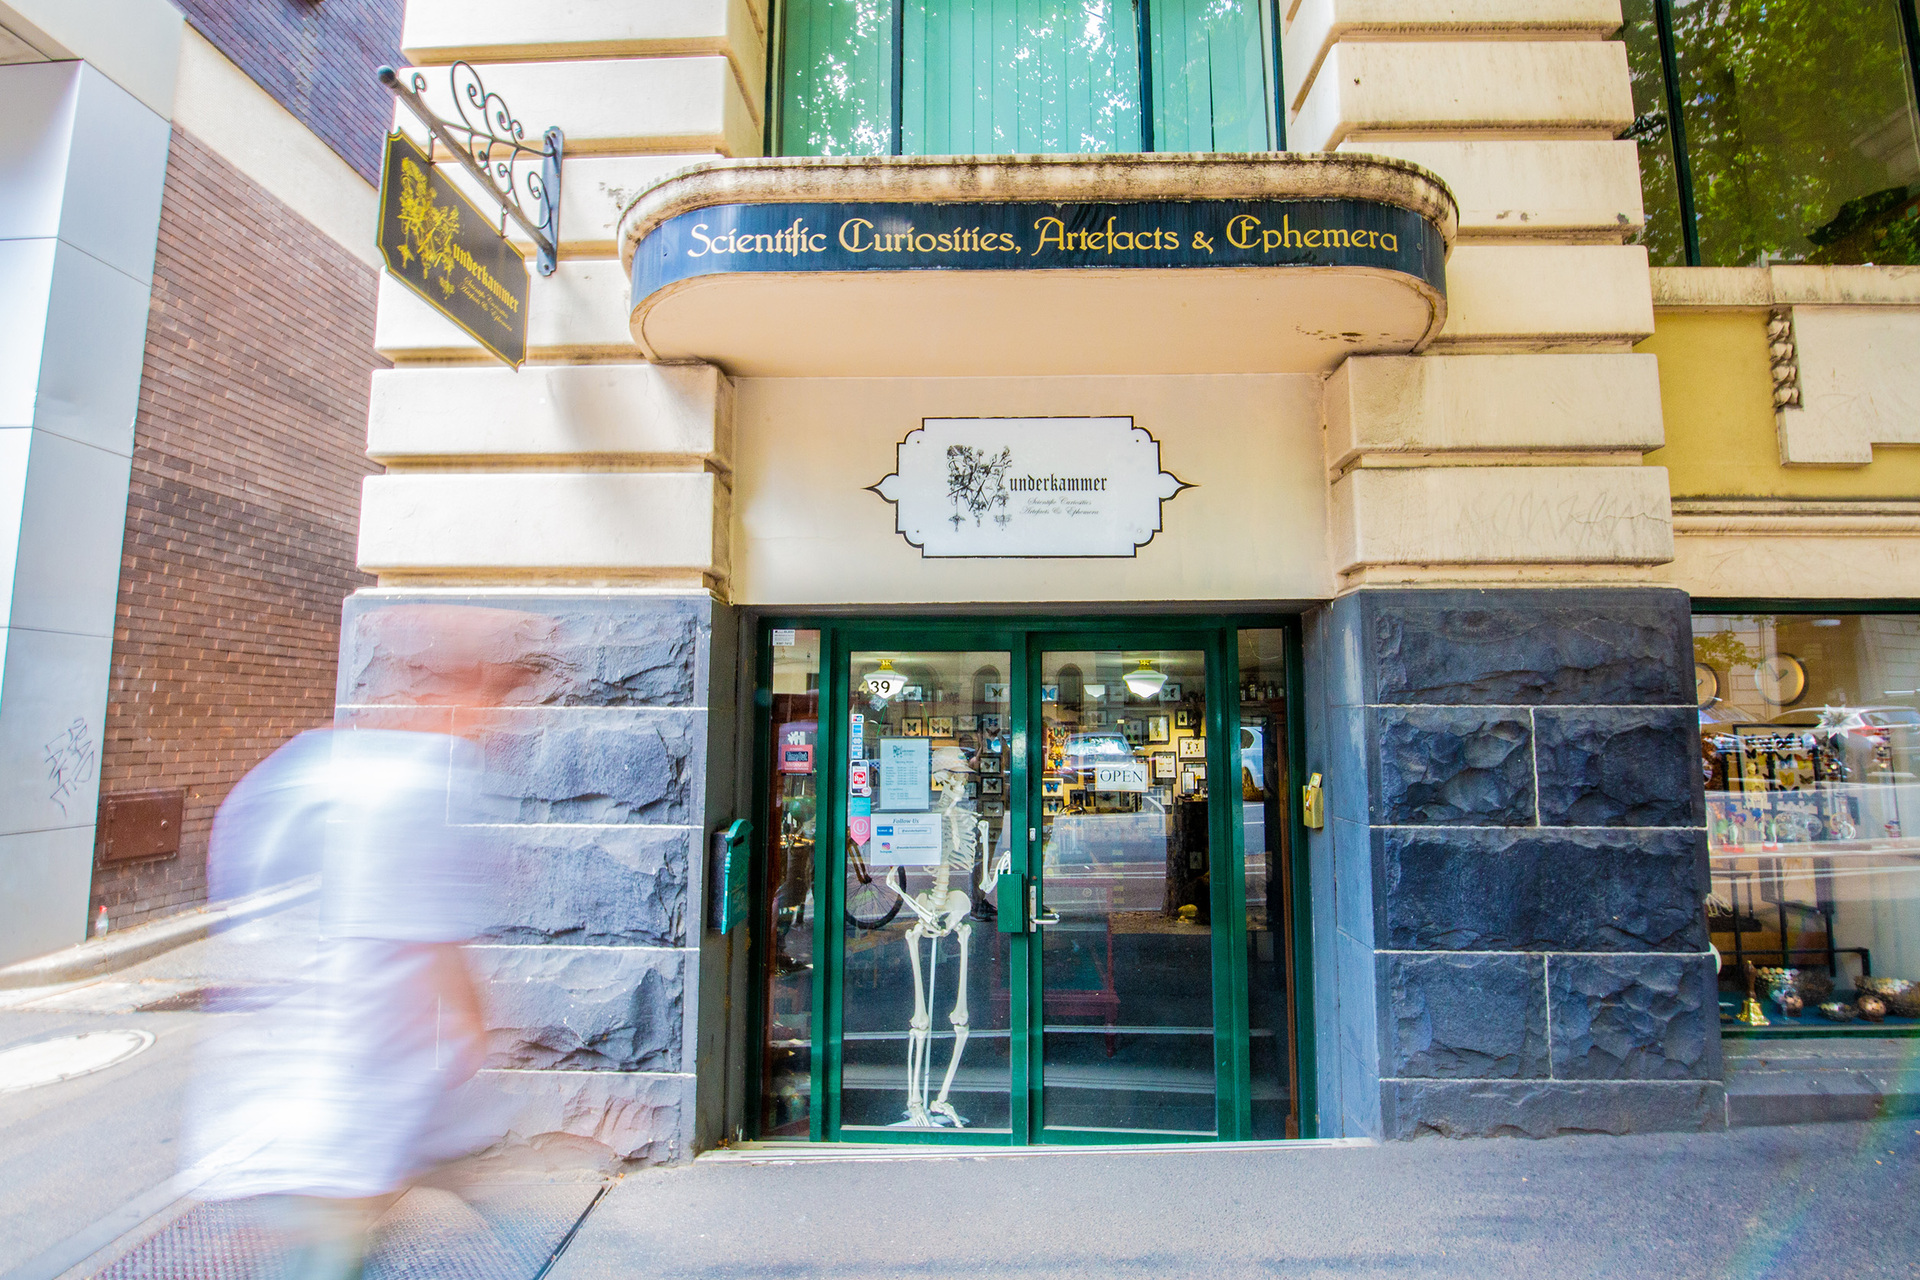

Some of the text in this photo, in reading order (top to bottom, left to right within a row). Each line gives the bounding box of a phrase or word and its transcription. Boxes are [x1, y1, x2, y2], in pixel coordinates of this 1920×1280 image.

[687, 213, 1399, 257] Scientific Curiosities, Artefacts & Ephemera
[1099, 769, 1144, 783] OPEN
